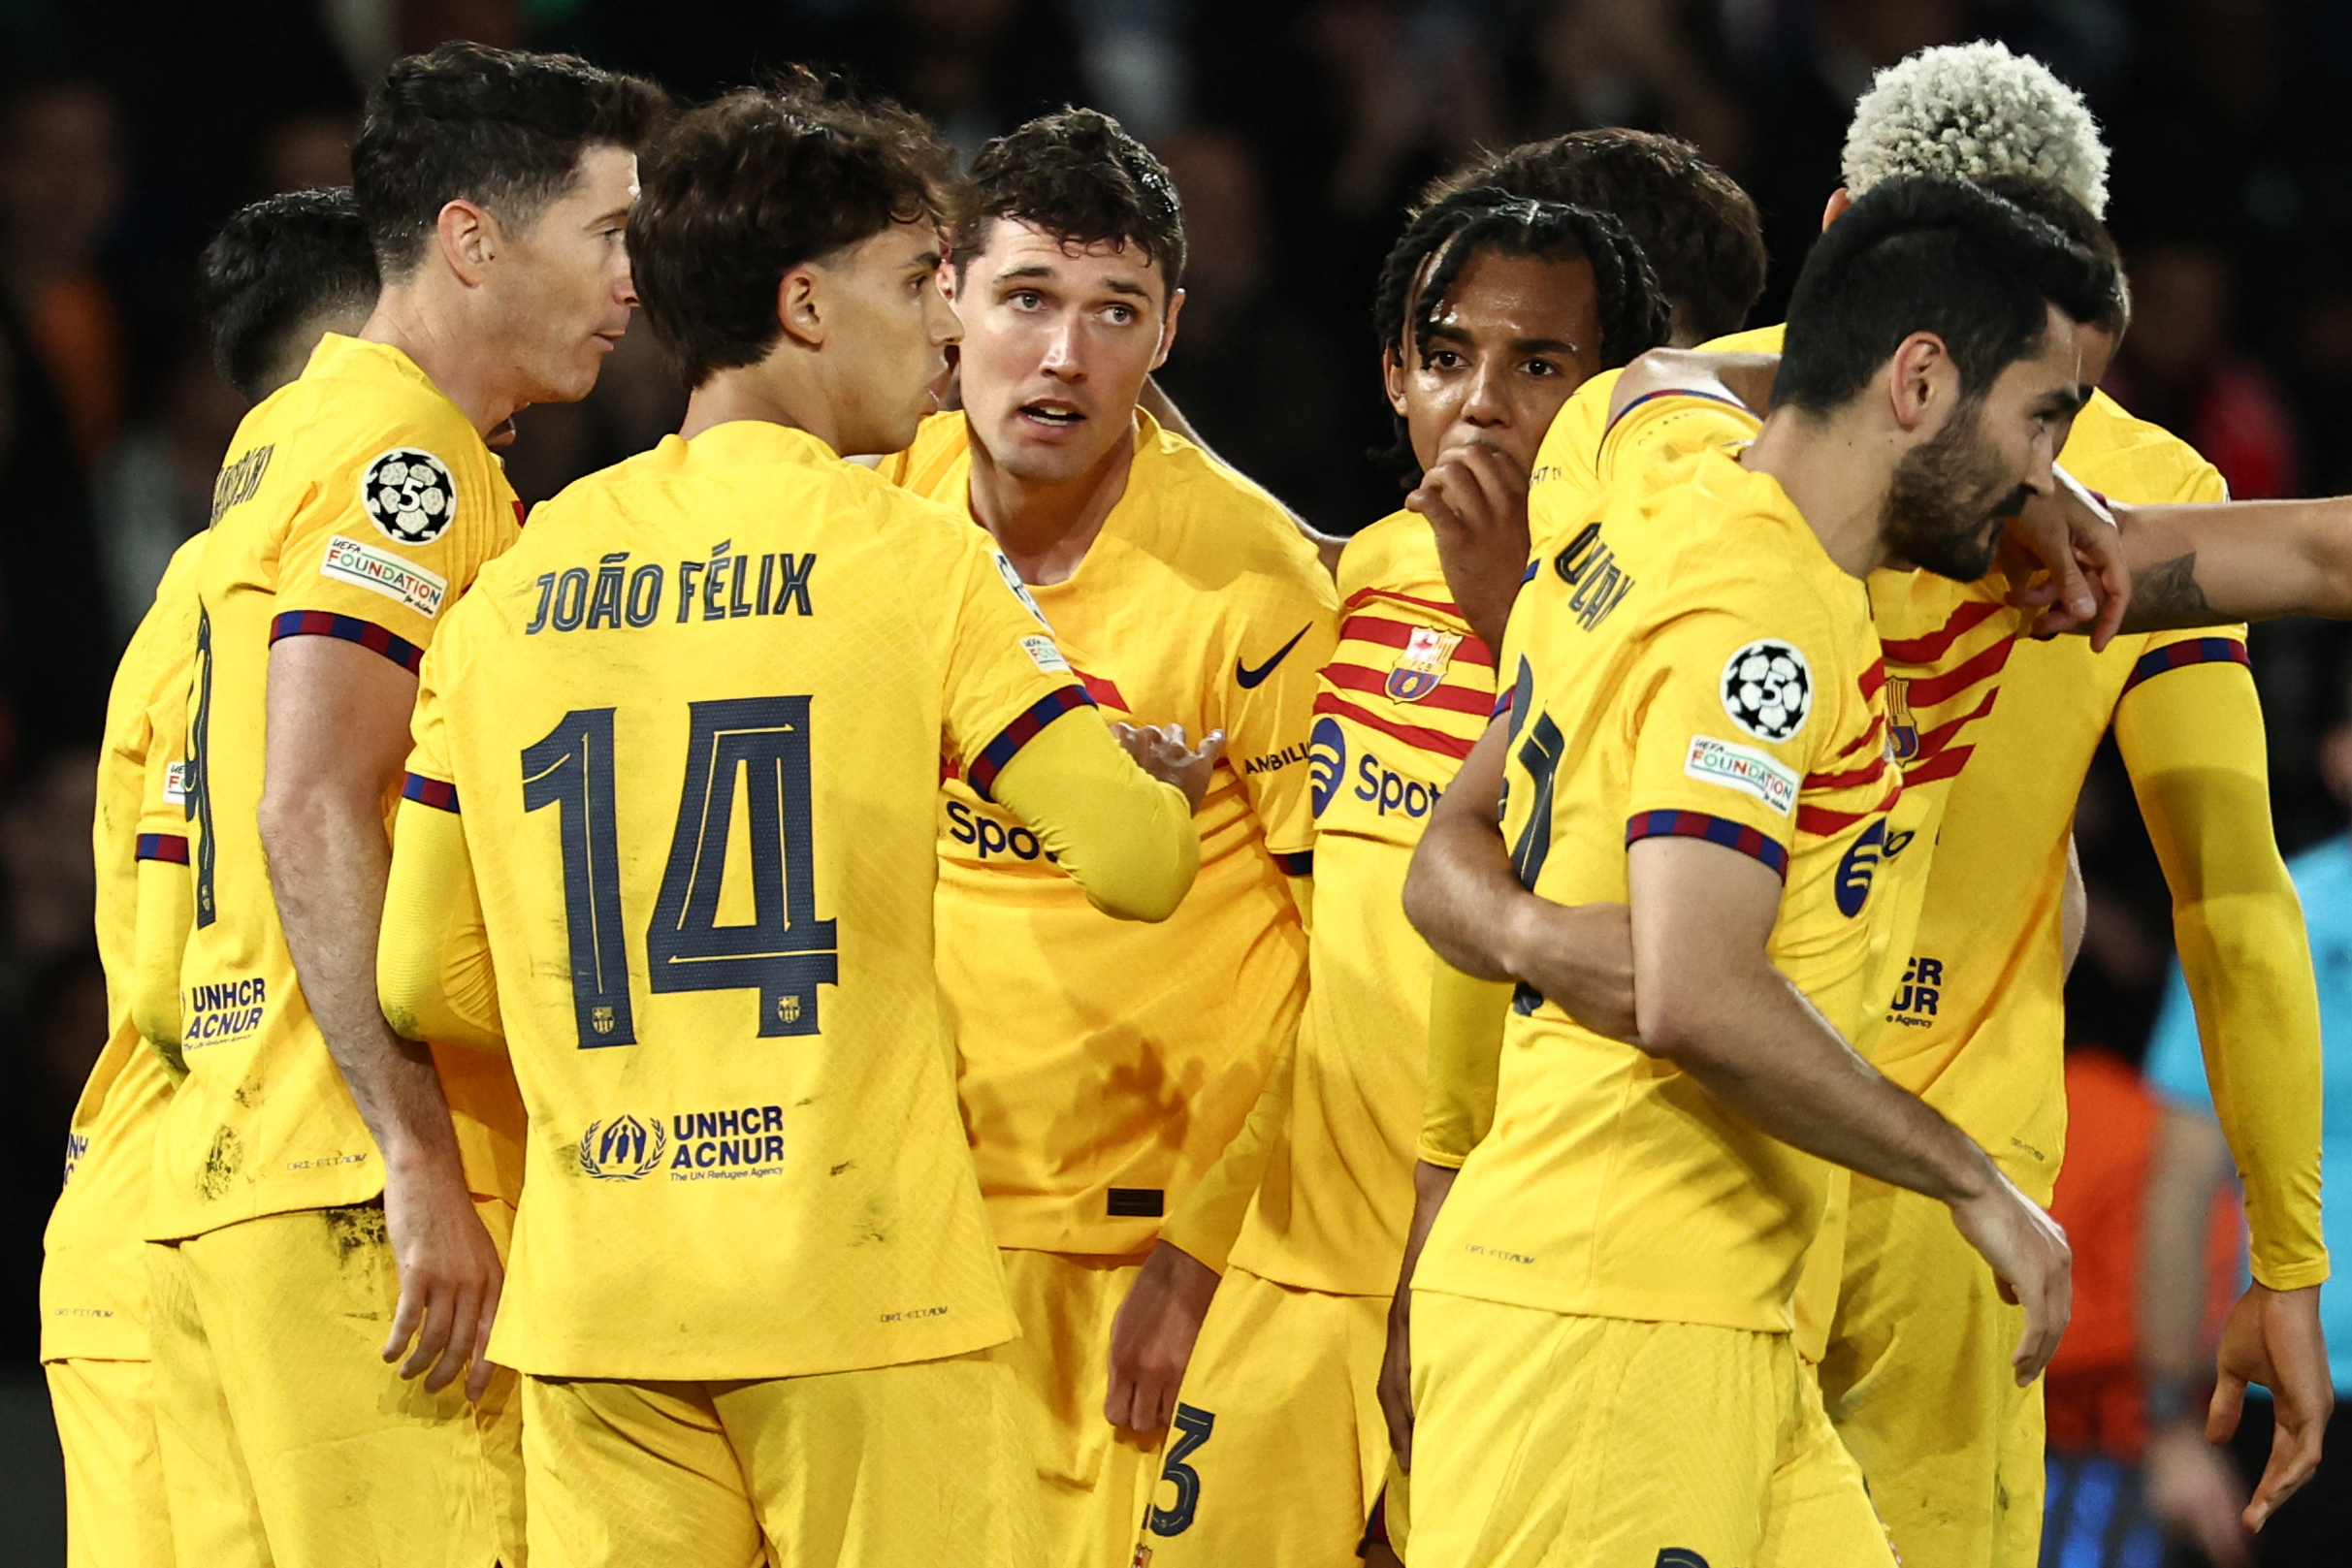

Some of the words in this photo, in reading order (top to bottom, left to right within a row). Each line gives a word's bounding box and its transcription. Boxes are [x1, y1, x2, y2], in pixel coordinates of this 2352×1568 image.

[397, 477, 424, 512] 5
[332, 539, 362, 554] UEFA
[327, 549, 441, 606] FOUNDATION
[525, 551, 664, 635] JOÃO
[675, 538, 817, 624] FÉLIX
[1759, 671, 1788, 708] 5
[1244, 742, 1311, 775] AMBILI
[1694, 739, 1724, 752] UEFA
[1692, 750, 1792, 802] FOUNDATION
[947, 801, 1058, 863] Spo
[520, 694, 838, 1050] 14
[192, 977, 266, 1012] UNHCR
[184, 1007, 264, 1040] ACNUR
[673, 1105, 784, 1141] UNHCR
[670, 1136, 785, 1169] ACNUR
[670, 1172, 688, 1181] The
[690, 1171, 705, 1181] UN
[707, 1168, 749, 1180] Refugee
[750, 1167, 784, 1178] Agency
